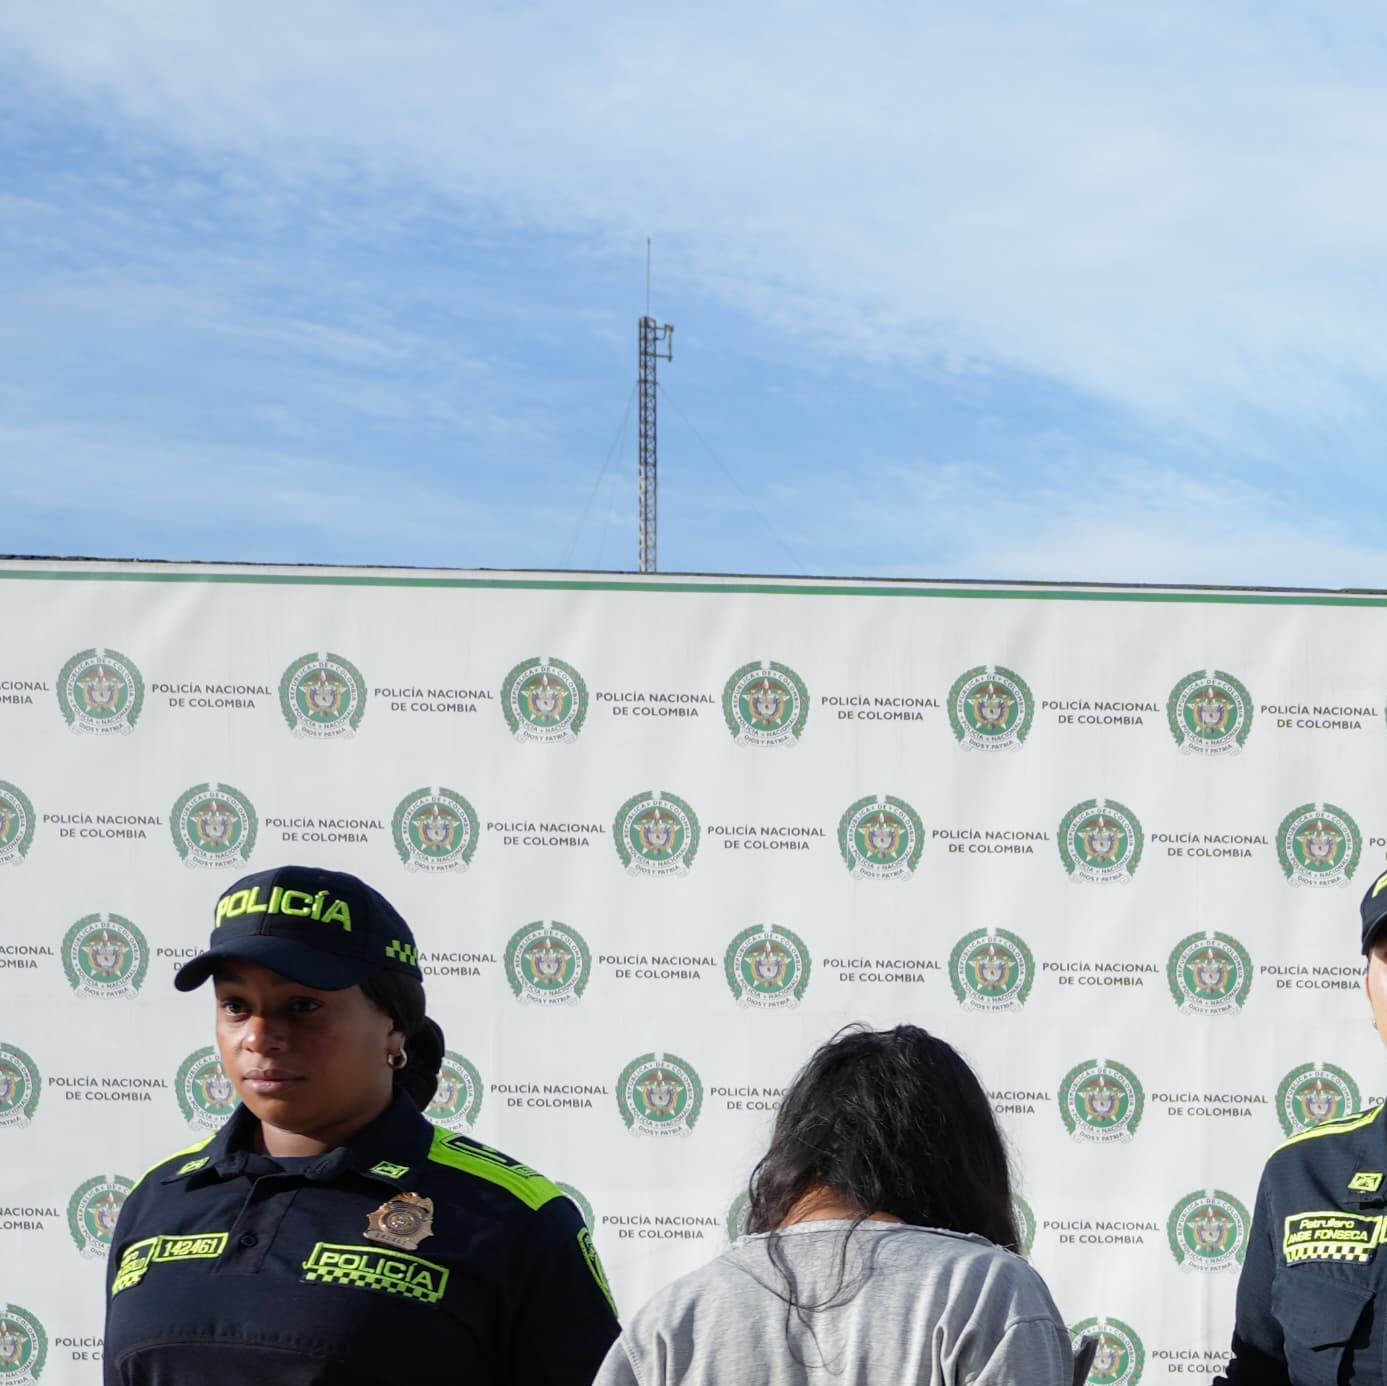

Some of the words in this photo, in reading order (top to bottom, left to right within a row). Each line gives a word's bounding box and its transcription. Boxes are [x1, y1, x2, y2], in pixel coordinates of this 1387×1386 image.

[151, 681, 203, 695] POLICÍA
[204, 683, 273, 696] NACIONAL
[168, 697, 186, 708] DE
[188, 697, 256, 709] COLOMBIA
[595, 690, 647, 703] POLICÍA
[648, 692, 716, 705] NACIONAL
[612, 705, 629, 717] DE
[631, 706, 700, 718] COLOMBIA
[1041, 698, 1092, 712] POLICÍA
[1093, 701, 1161, 713] NACIONAL
[1056, 712, 1075, 725] DE
[1076, 714, 1144, 727] COLOMBIA
[42, 812, 94, 825] POLICÍA
[96, 815, 164, 826] NACIONAL
[59, 827, 77, 838] DE
[79, 828, 147, 840] COLOMBIA
[486, 820, 537, 833] POLICÍA
[539, 822, 607, 834] NACIONAL
[931, 827, 983, 841] POLICÍA
[984, 830, 1051, 841] NACIONAL
[503, 835, 520, 846] DE
[522, 835, 590, 848] COLOMBIA
[948, 842, 966, 854] DE
[967, 843, 1035, 855] COLOMBIA
[214, 885, 352, 933] POLICÍA
[598, 953, 649, 966] POLICÍA
[651, 955, 718, 967] NACIONAL
[1042, 959, 1092, 973] POLICÍA
[1094, 962, 1161, 974] NACIONAL
[615, 968, 632, 979] DE
[634, 968, 701, 980] COLOMBIA
[1058, 975, 1075, 986] DE
[1077, 975, 1145, 987] COLOMBIA
[48, 1075, 99, 1088] POLICÍA
[100, 1077, 169, 1089] NACIONAL
[65, 1090, 82, 1101] DE
[84, 1090, 152, 1102] COLOMBIA
[1151, 1091, 1201, 1104] POLICÍA
[1203, 1093, 1269, 1105] NACIONAL
[1167, 1106, 1184, 1117] DE
[1186, 1106, 1253, 1118] COLOMBIA
[601, 1213, 652, 1226] POLICÍA
[654, 1215, 721, 1227] NACIONAL
[618, 1228, 635, 1239] DE
[637, 1229, 705, 1240] COLOMBIA
[162, 1238, 219, 1257] 142461
[318, 1250, 435, 1291] POLICÍA
